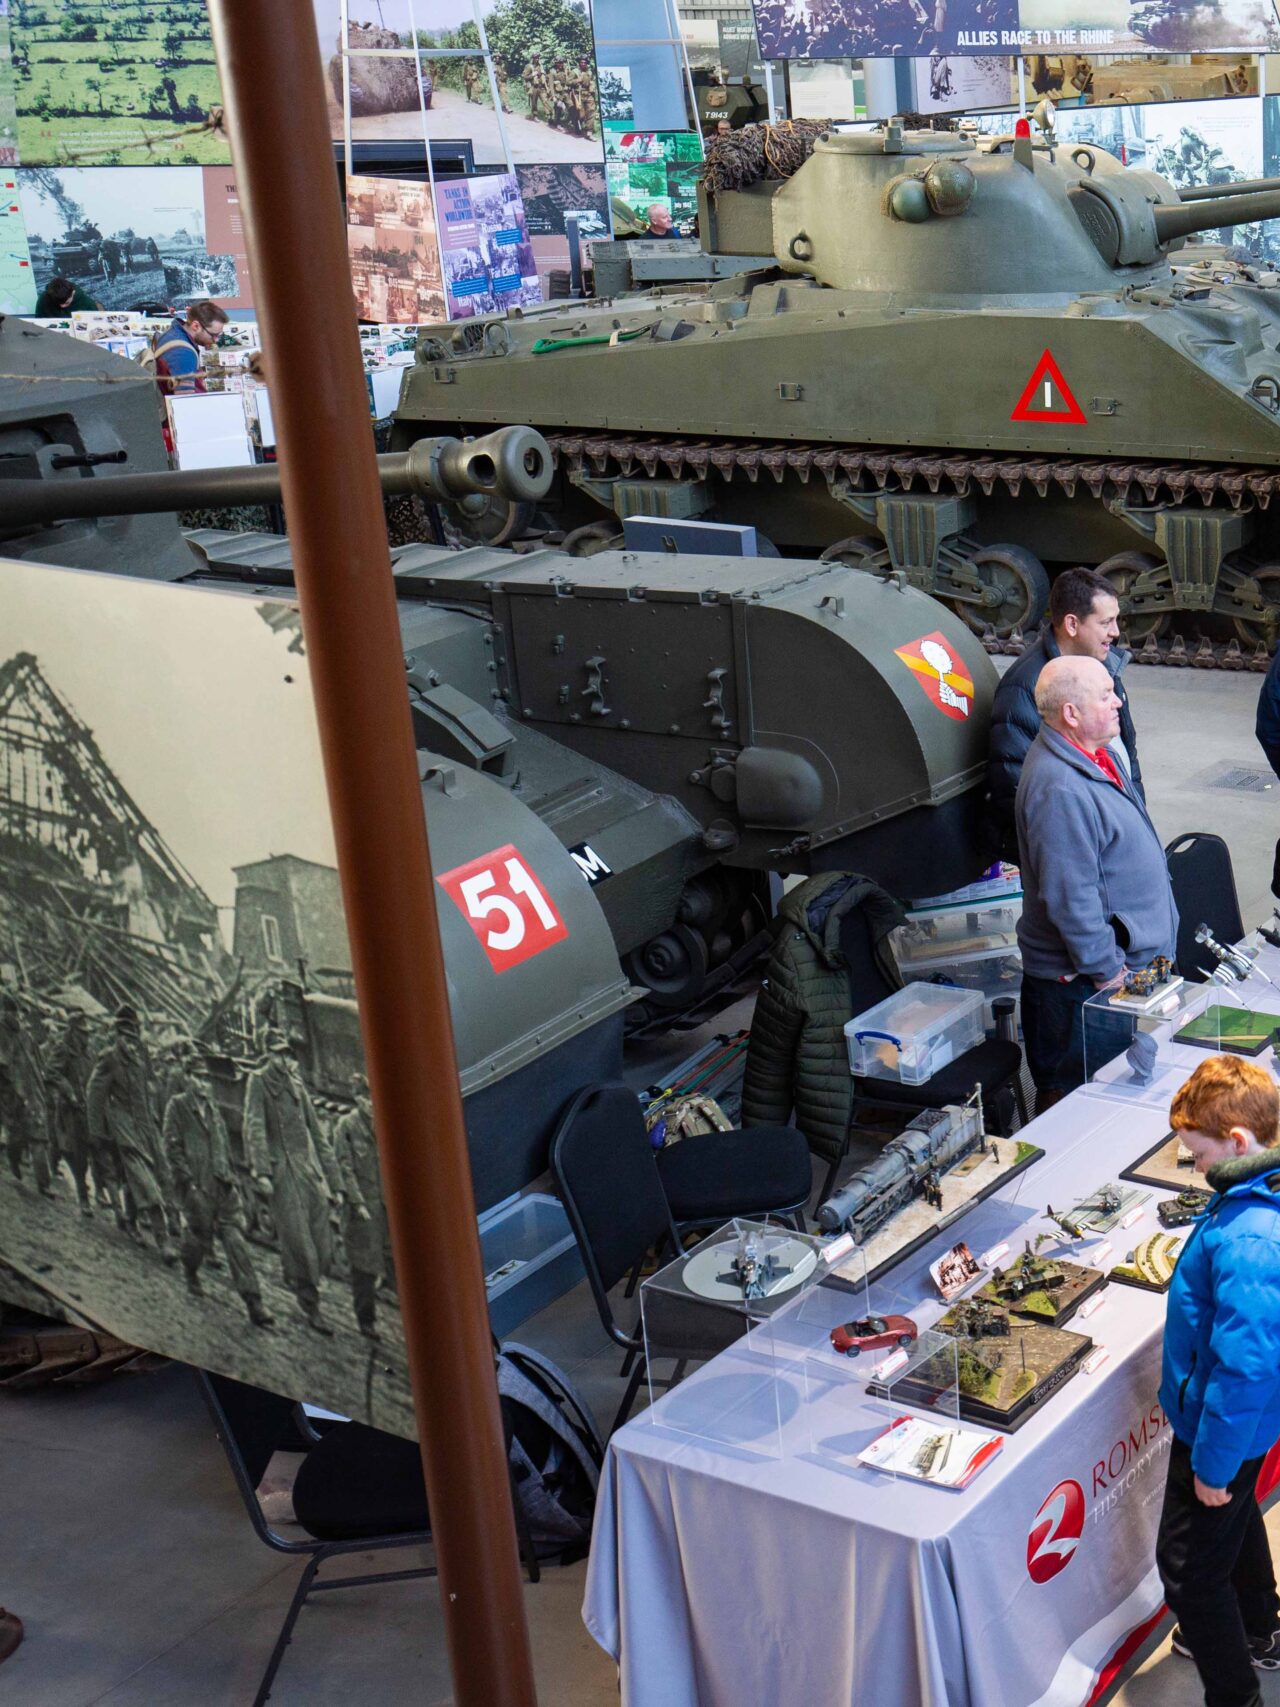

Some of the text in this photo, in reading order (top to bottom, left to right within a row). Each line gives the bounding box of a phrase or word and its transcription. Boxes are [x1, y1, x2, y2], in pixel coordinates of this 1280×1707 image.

[957, 30, 1114, 46] ALLIES RACE TO THE RHINE
[570, 846, 612, 882] M
[459, 858, 558, 951] 51
[1094, 1448, 1154, 1524] HISTORY
